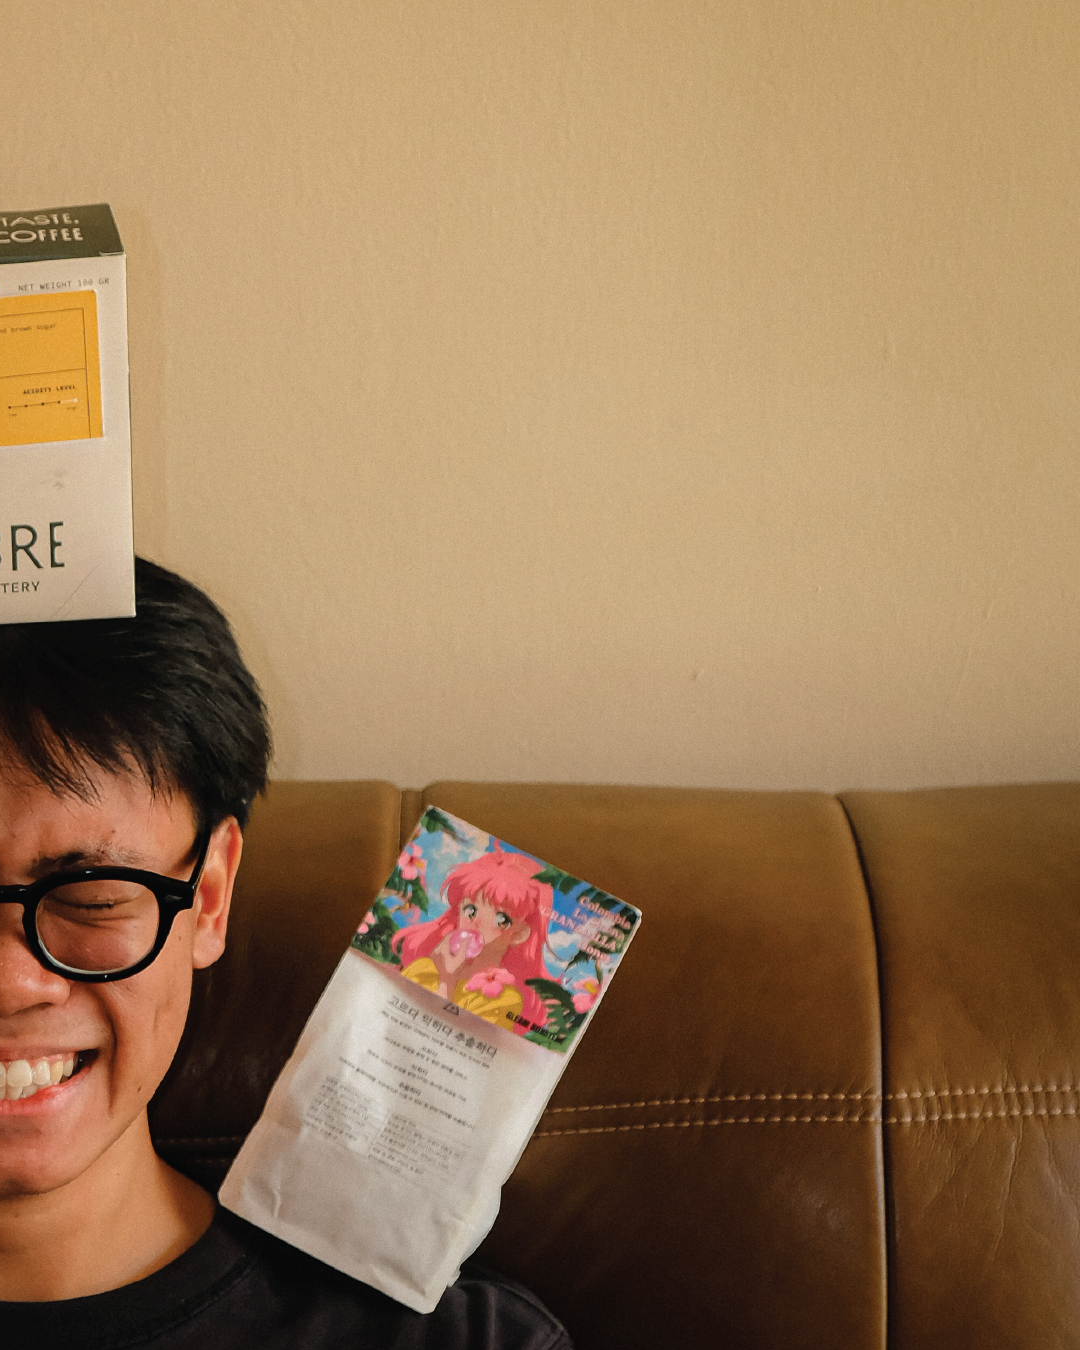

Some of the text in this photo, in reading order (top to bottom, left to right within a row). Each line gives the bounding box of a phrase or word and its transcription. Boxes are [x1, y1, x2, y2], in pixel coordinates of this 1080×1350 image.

[18, 284, 34, 292] NET
[39, 281, 72, 290] WEIGHT
[98, 277, 110, 285] GR
[56, 384, 76, 392] LEVEL
[578, 895, 631, 930] Colombia
